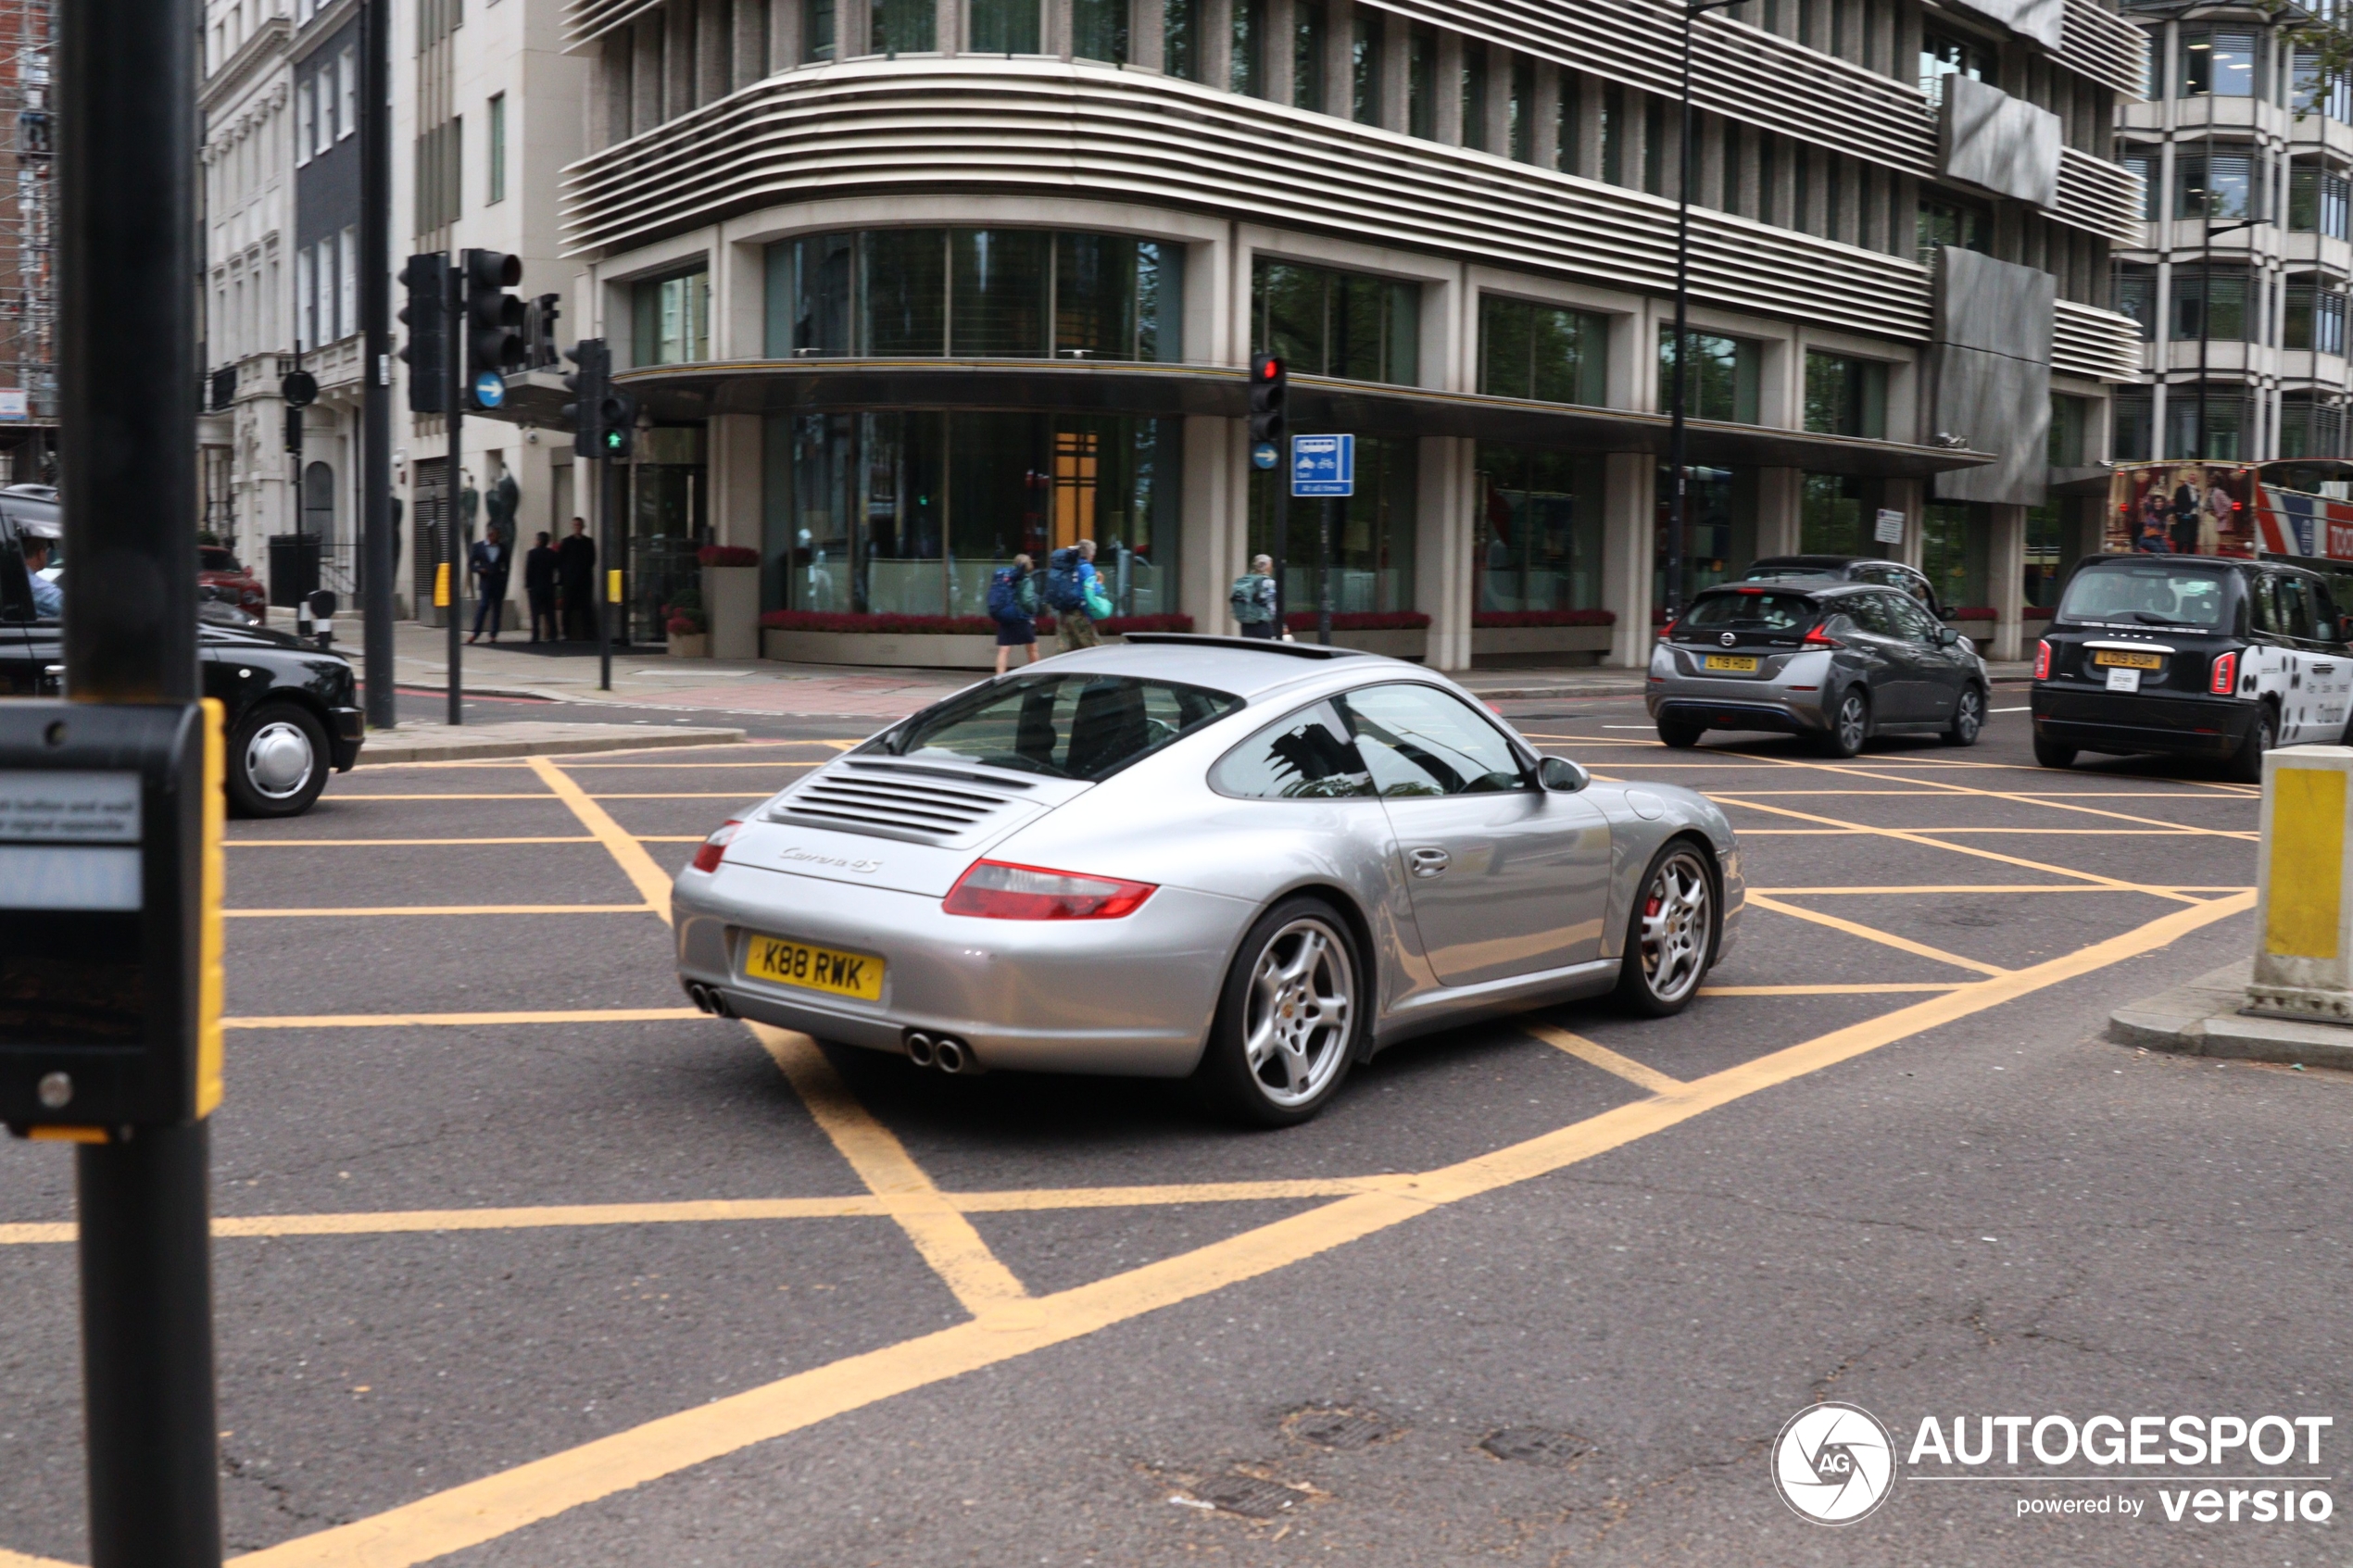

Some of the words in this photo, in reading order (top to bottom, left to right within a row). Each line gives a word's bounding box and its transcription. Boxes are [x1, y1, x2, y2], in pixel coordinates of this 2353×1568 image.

[778, 847, 848, 867] Carrera
[849, 859, 884, 873] 4S
[762, 942, 808, 978] K88
[813, 952, 864, 990] RWK
